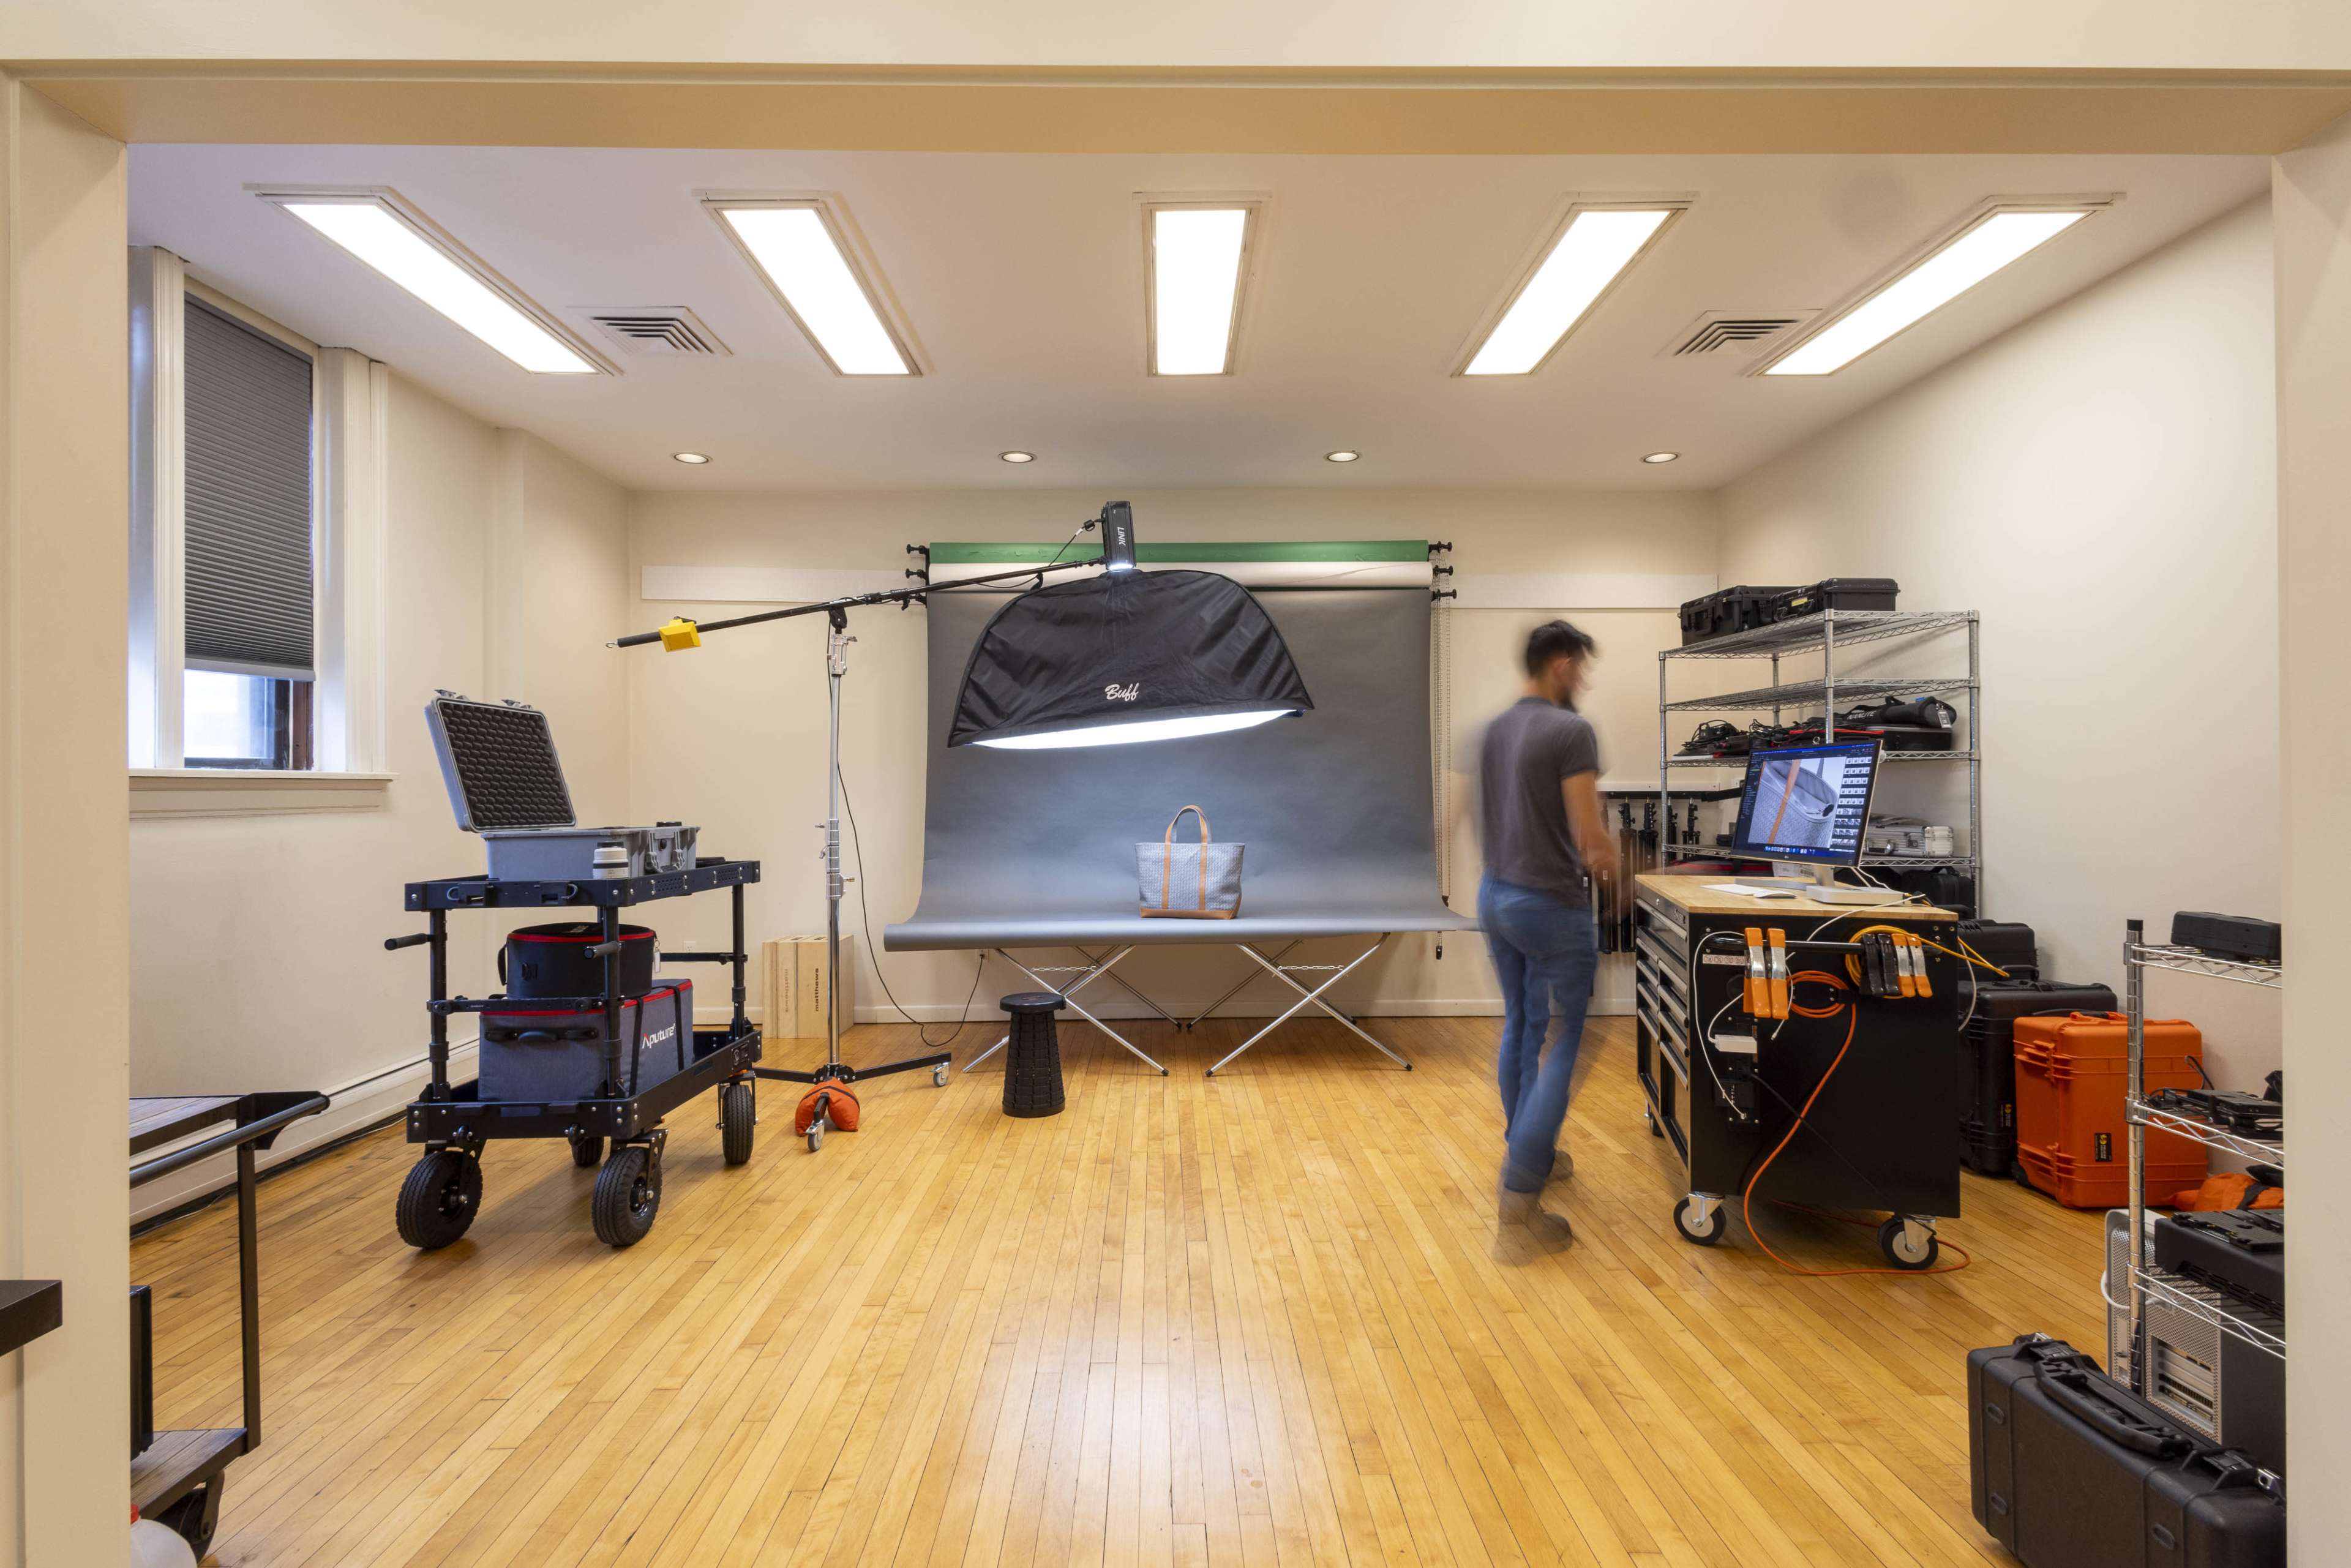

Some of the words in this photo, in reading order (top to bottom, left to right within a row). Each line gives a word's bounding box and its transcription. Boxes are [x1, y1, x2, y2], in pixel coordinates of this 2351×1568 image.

[1117, 527, 1126, 546] LINK
[1104, 682, 1139, 702] Buff
[642, 1024, 675, 1049] Aputure
